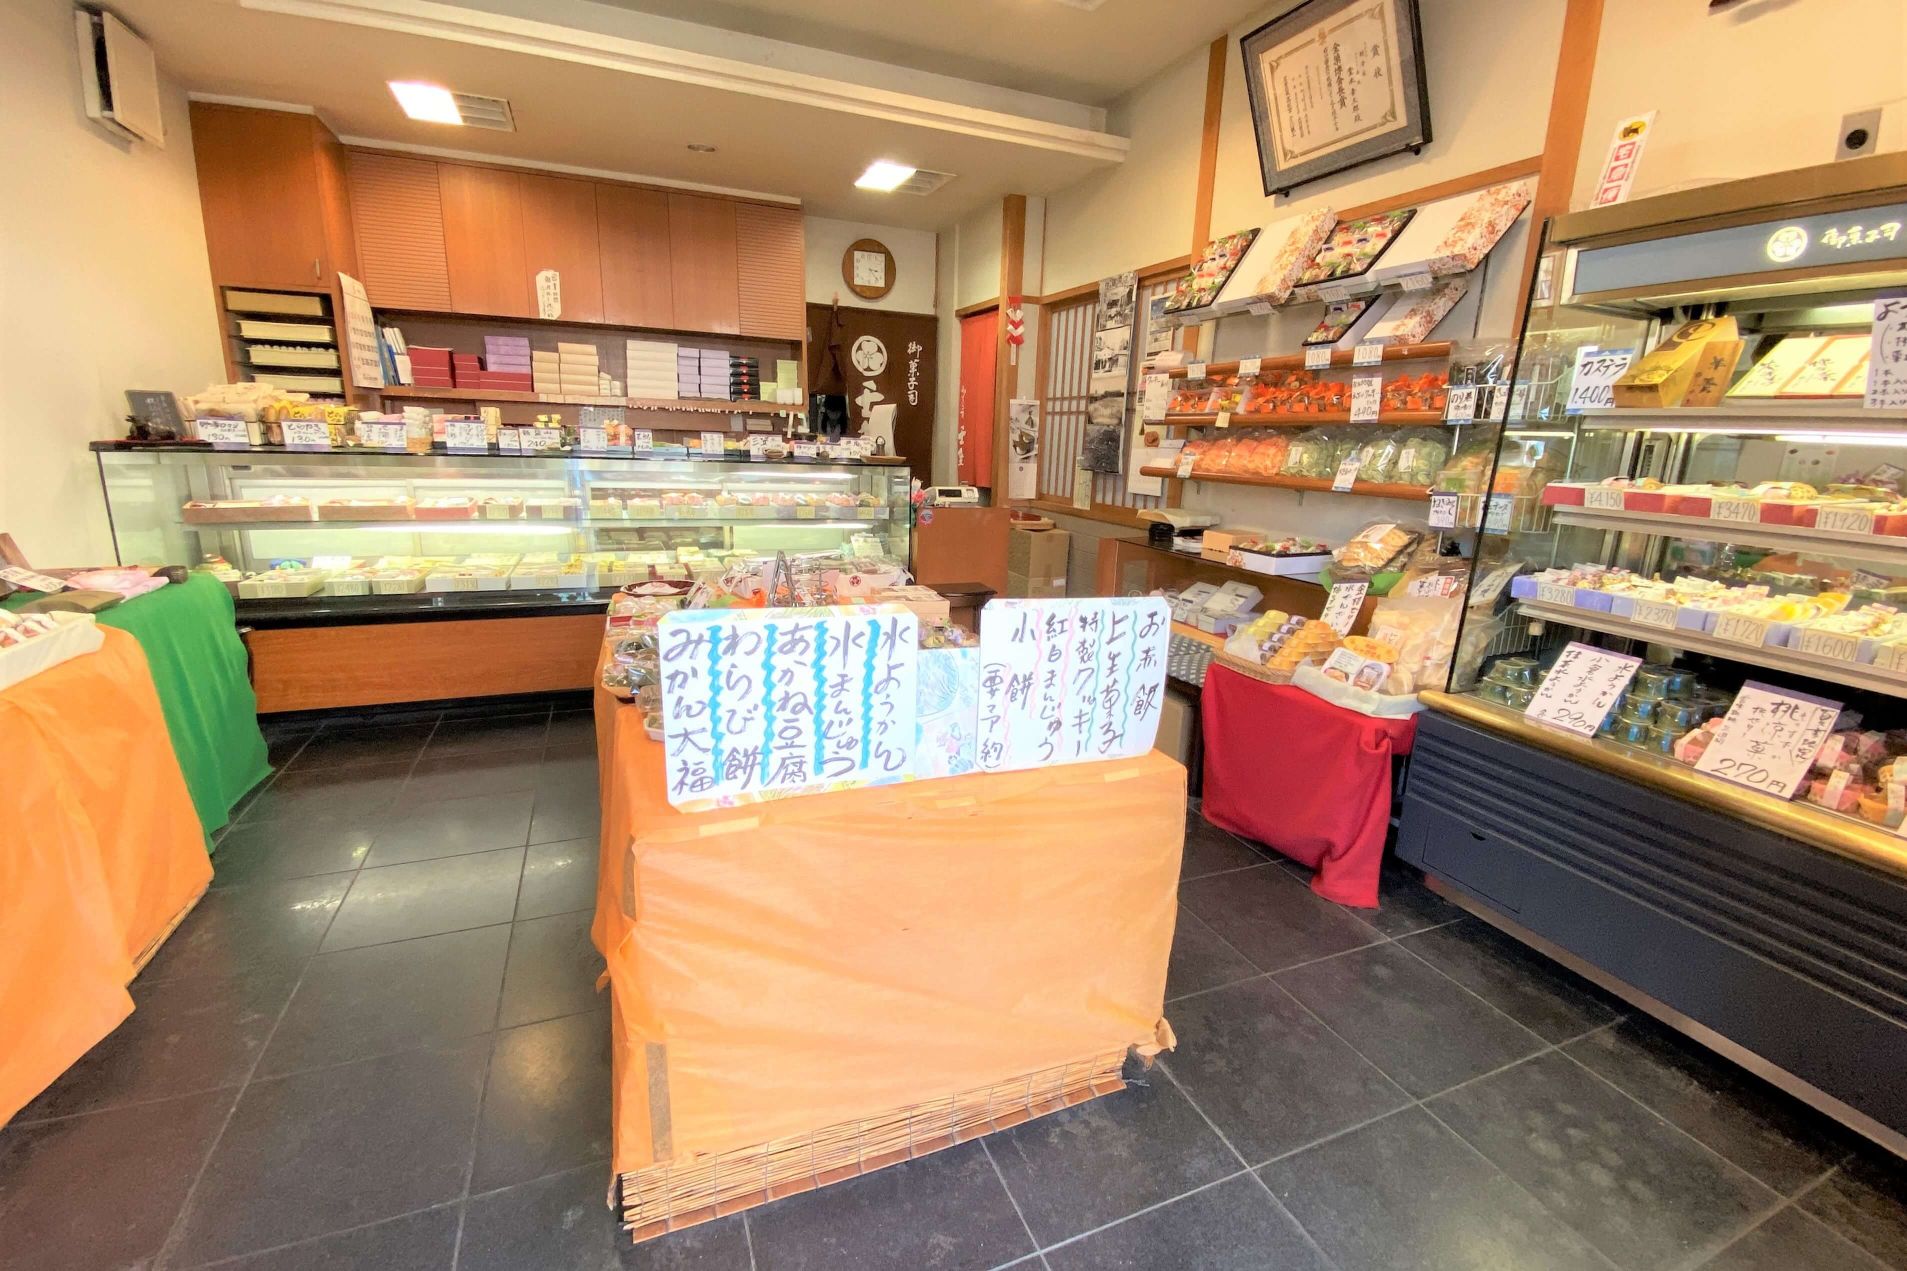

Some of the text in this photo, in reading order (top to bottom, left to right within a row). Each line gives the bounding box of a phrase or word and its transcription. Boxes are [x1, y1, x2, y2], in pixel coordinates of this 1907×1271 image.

[1820, 221, 1903, 250] 御菓子司
[906, 341, 923, 406] 御菓子司
[1579, 356, 1629, 381] カステラ
[1714, 499, 1758, 521] ¥3470
[662, 628, 714, 796] みかん大福
[721, 625, 766, 790] わらび餅
[763, 622, 815, 788] あかね豆腐
[819, 619, 866, 779] 水まんじゅう
[873, 615, 909, 772] 水ようかん
[980, 662, 1007, 769] (要予約)
[1004, 611, 1037, 711] 小餅
[1038, 612, 1070, 762] 紅白まんじゅう
[1071, 611, 1099, 757] 特製クッキー
[1098, 610, 1130, 755] 上生菓子
[1133, 610, 1166, 722] お赤飯
[1591, 662, 1634, 709] 水ようかん
[1710, 757, 1789, 794] 270円
